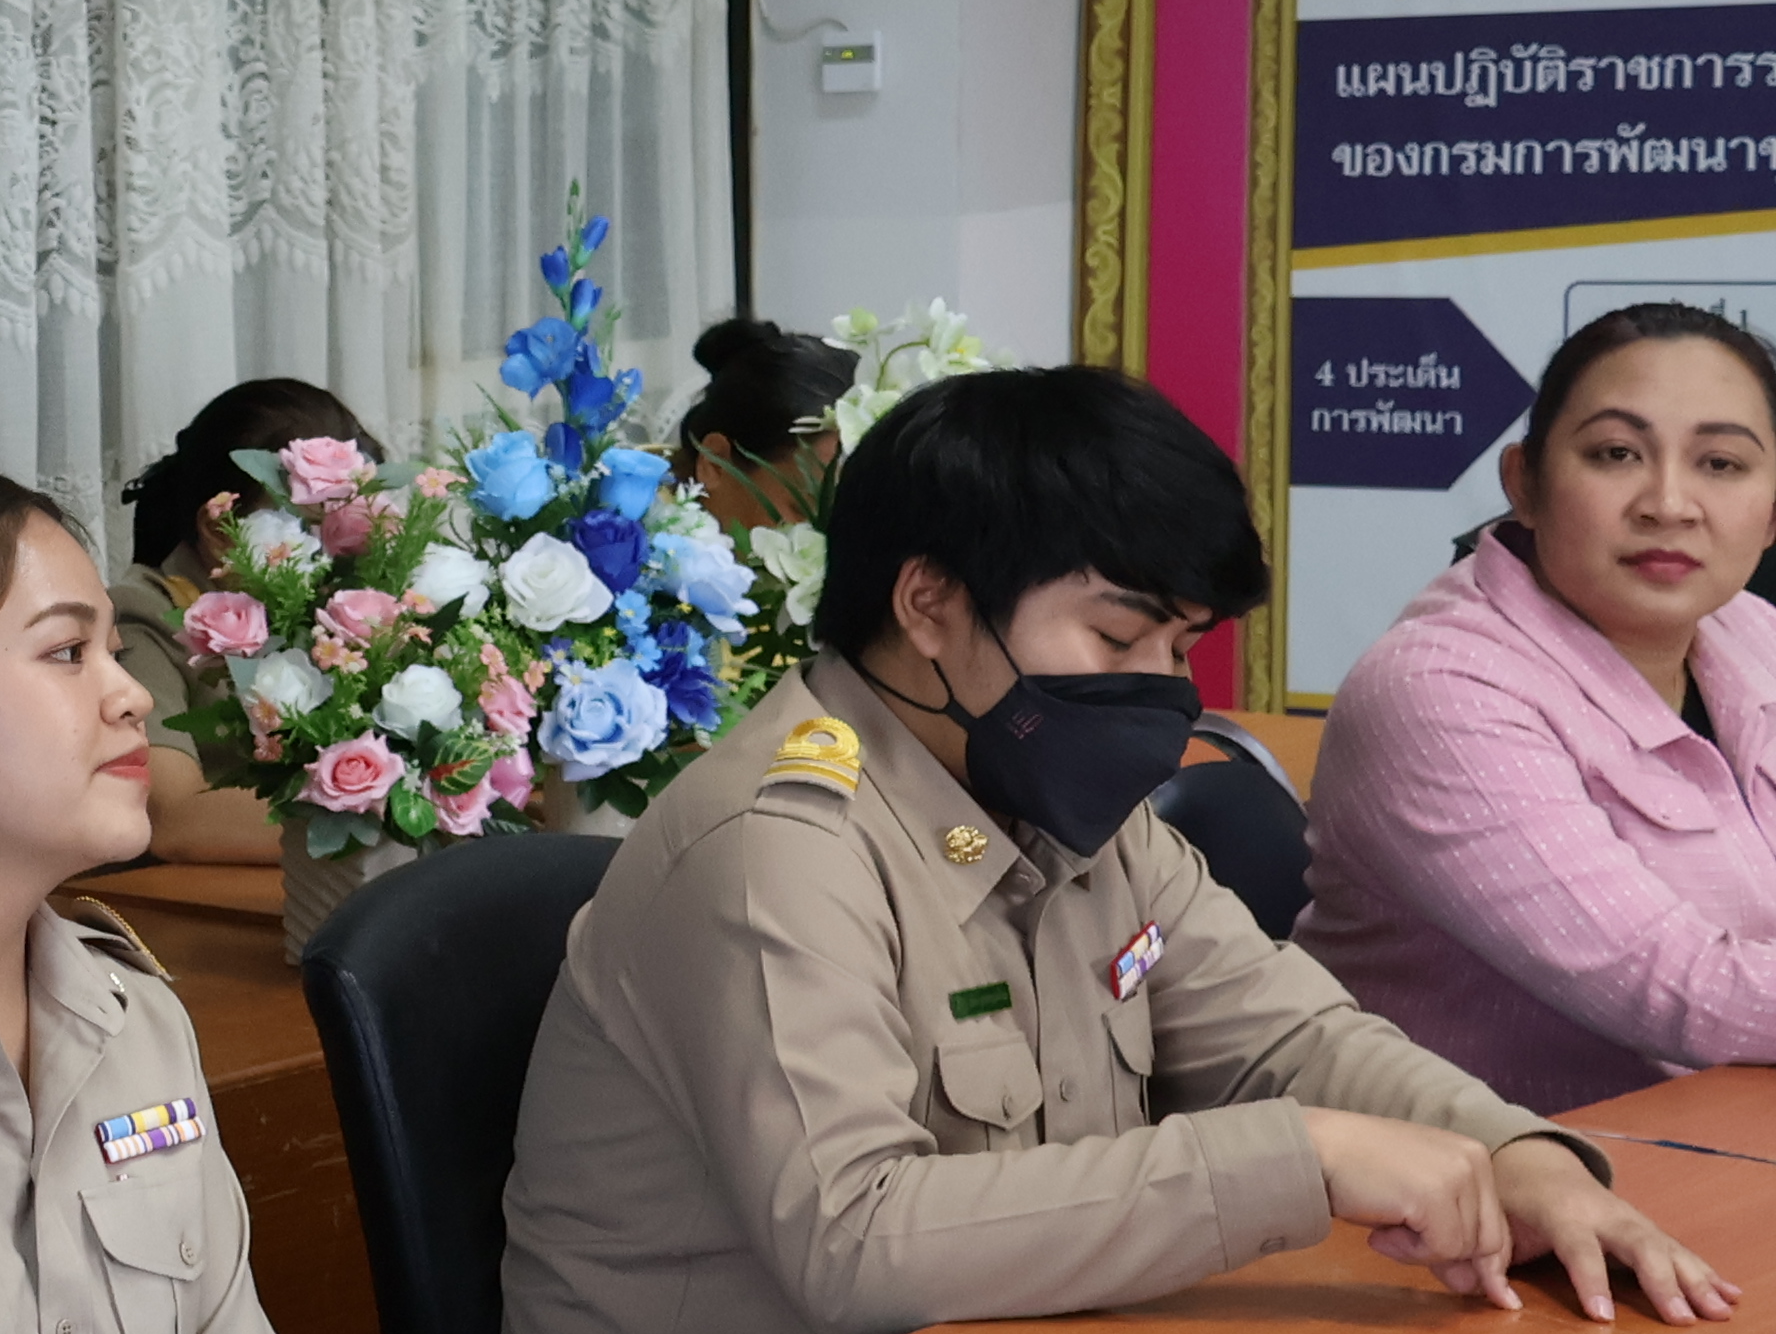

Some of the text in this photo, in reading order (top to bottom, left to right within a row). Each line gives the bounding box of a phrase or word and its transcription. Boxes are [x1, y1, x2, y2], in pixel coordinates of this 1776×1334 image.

[1315, 355, 1461, 391] 4 ประเด็น
[1312, 401, 1463, 436] การพัฒนา
